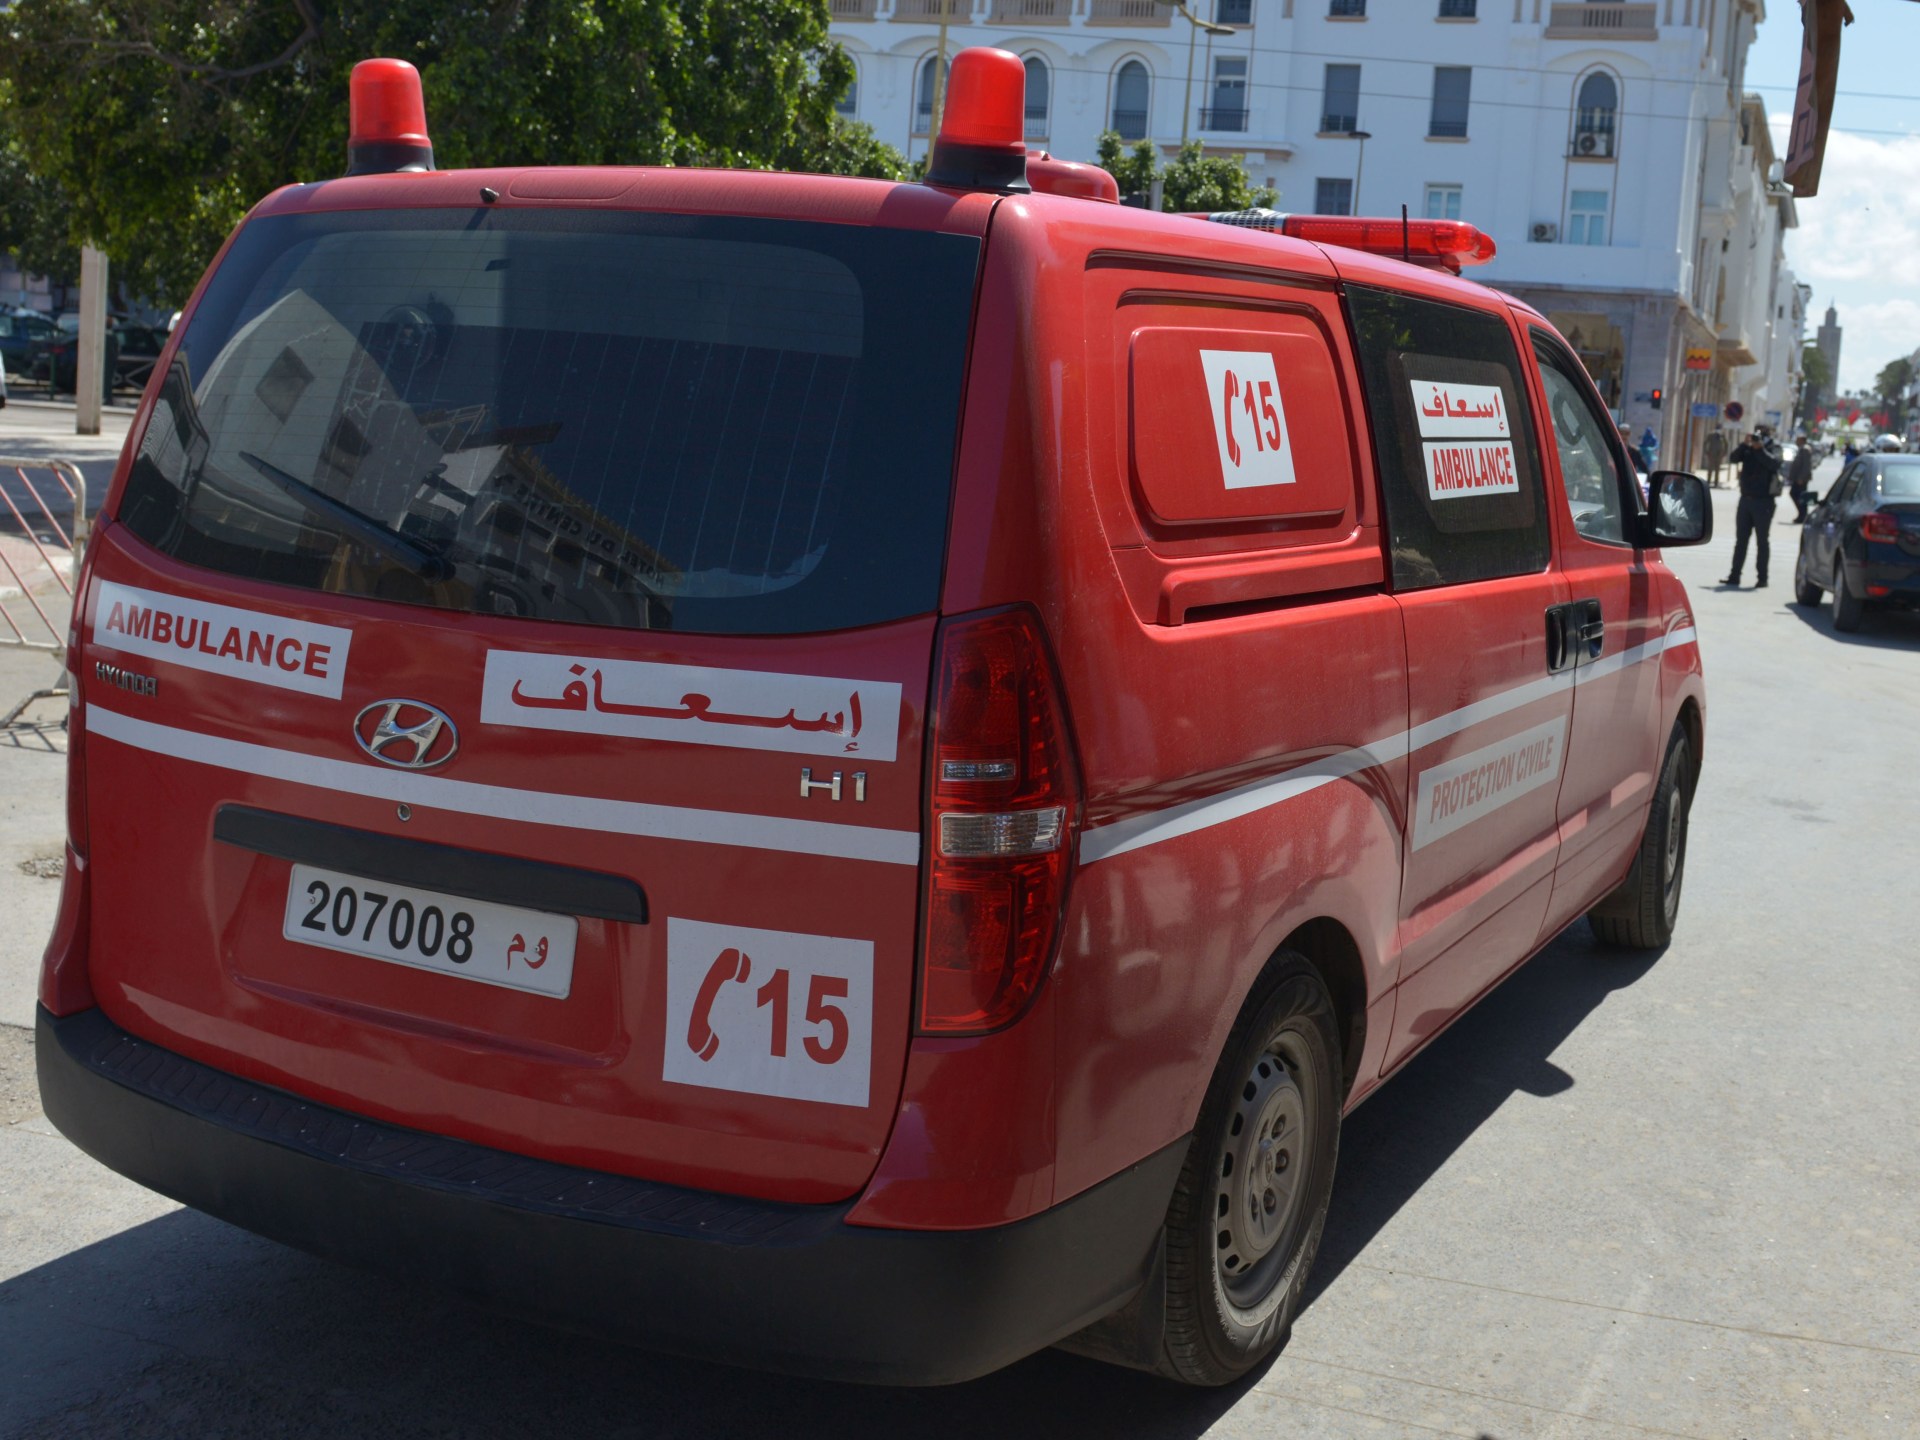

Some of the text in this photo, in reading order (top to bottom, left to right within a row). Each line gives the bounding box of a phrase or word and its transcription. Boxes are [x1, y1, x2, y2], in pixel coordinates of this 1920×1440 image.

[1244, 380, 1281, 452] 15
[1422, 386, 1505, 432] إسعاف
[1433, 447, 1514, 491] AMBULANCE
[106, 602, 331, 678] AMBULANCE
[511, 663, 863, 753] إسعاف
[801, 767, 868, 802] H1
[1430, 735, 1554, 824] PROTECTION CIVILE
[302, 880, 475, 964] 207008
[757, 968, 849, 1065] 15
